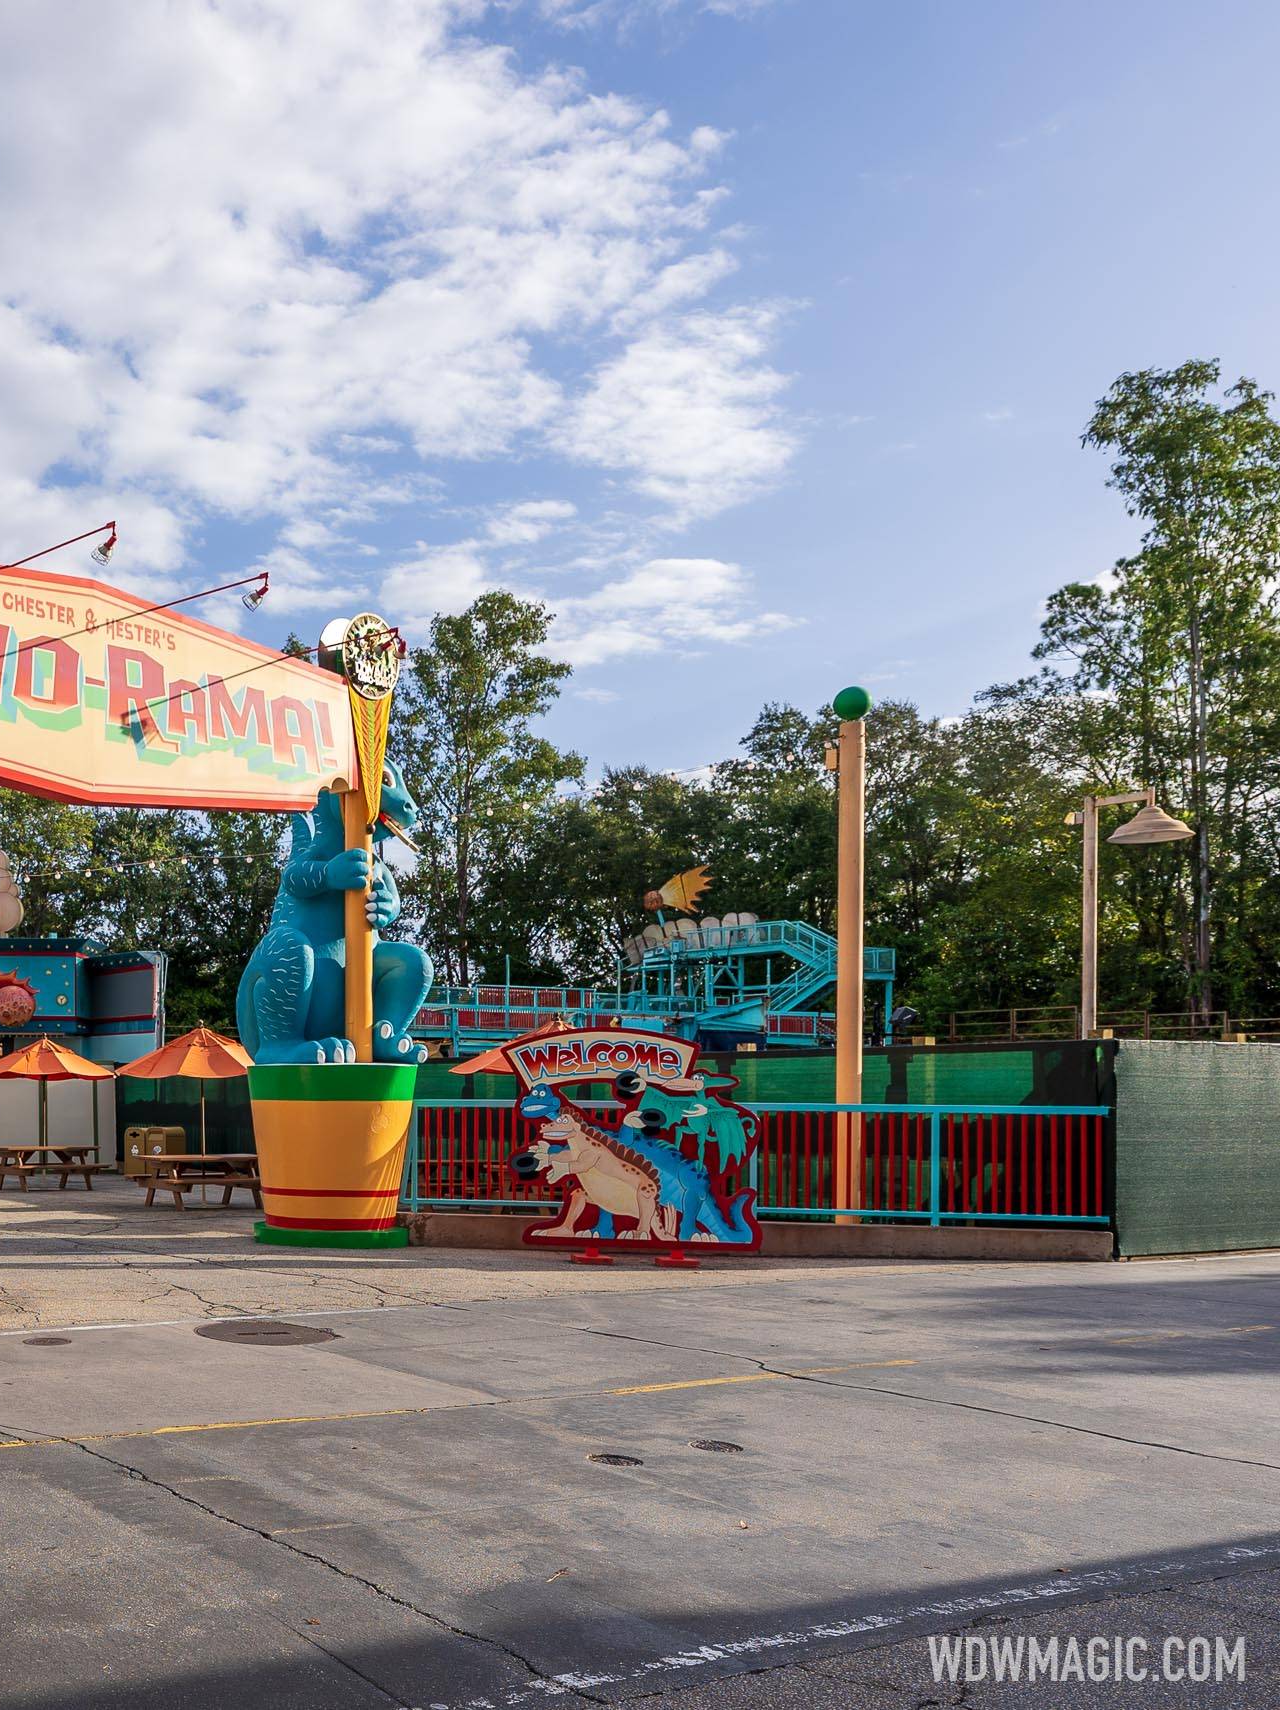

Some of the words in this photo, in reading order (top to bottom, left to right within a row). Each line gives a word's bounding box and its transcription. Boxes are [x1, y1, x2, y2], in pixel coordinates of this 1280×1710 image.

[1, 592, 76, 628] CHESTER
[84, 608, 99, 635] &
[106, 617, 177, 651] HESTER'S
